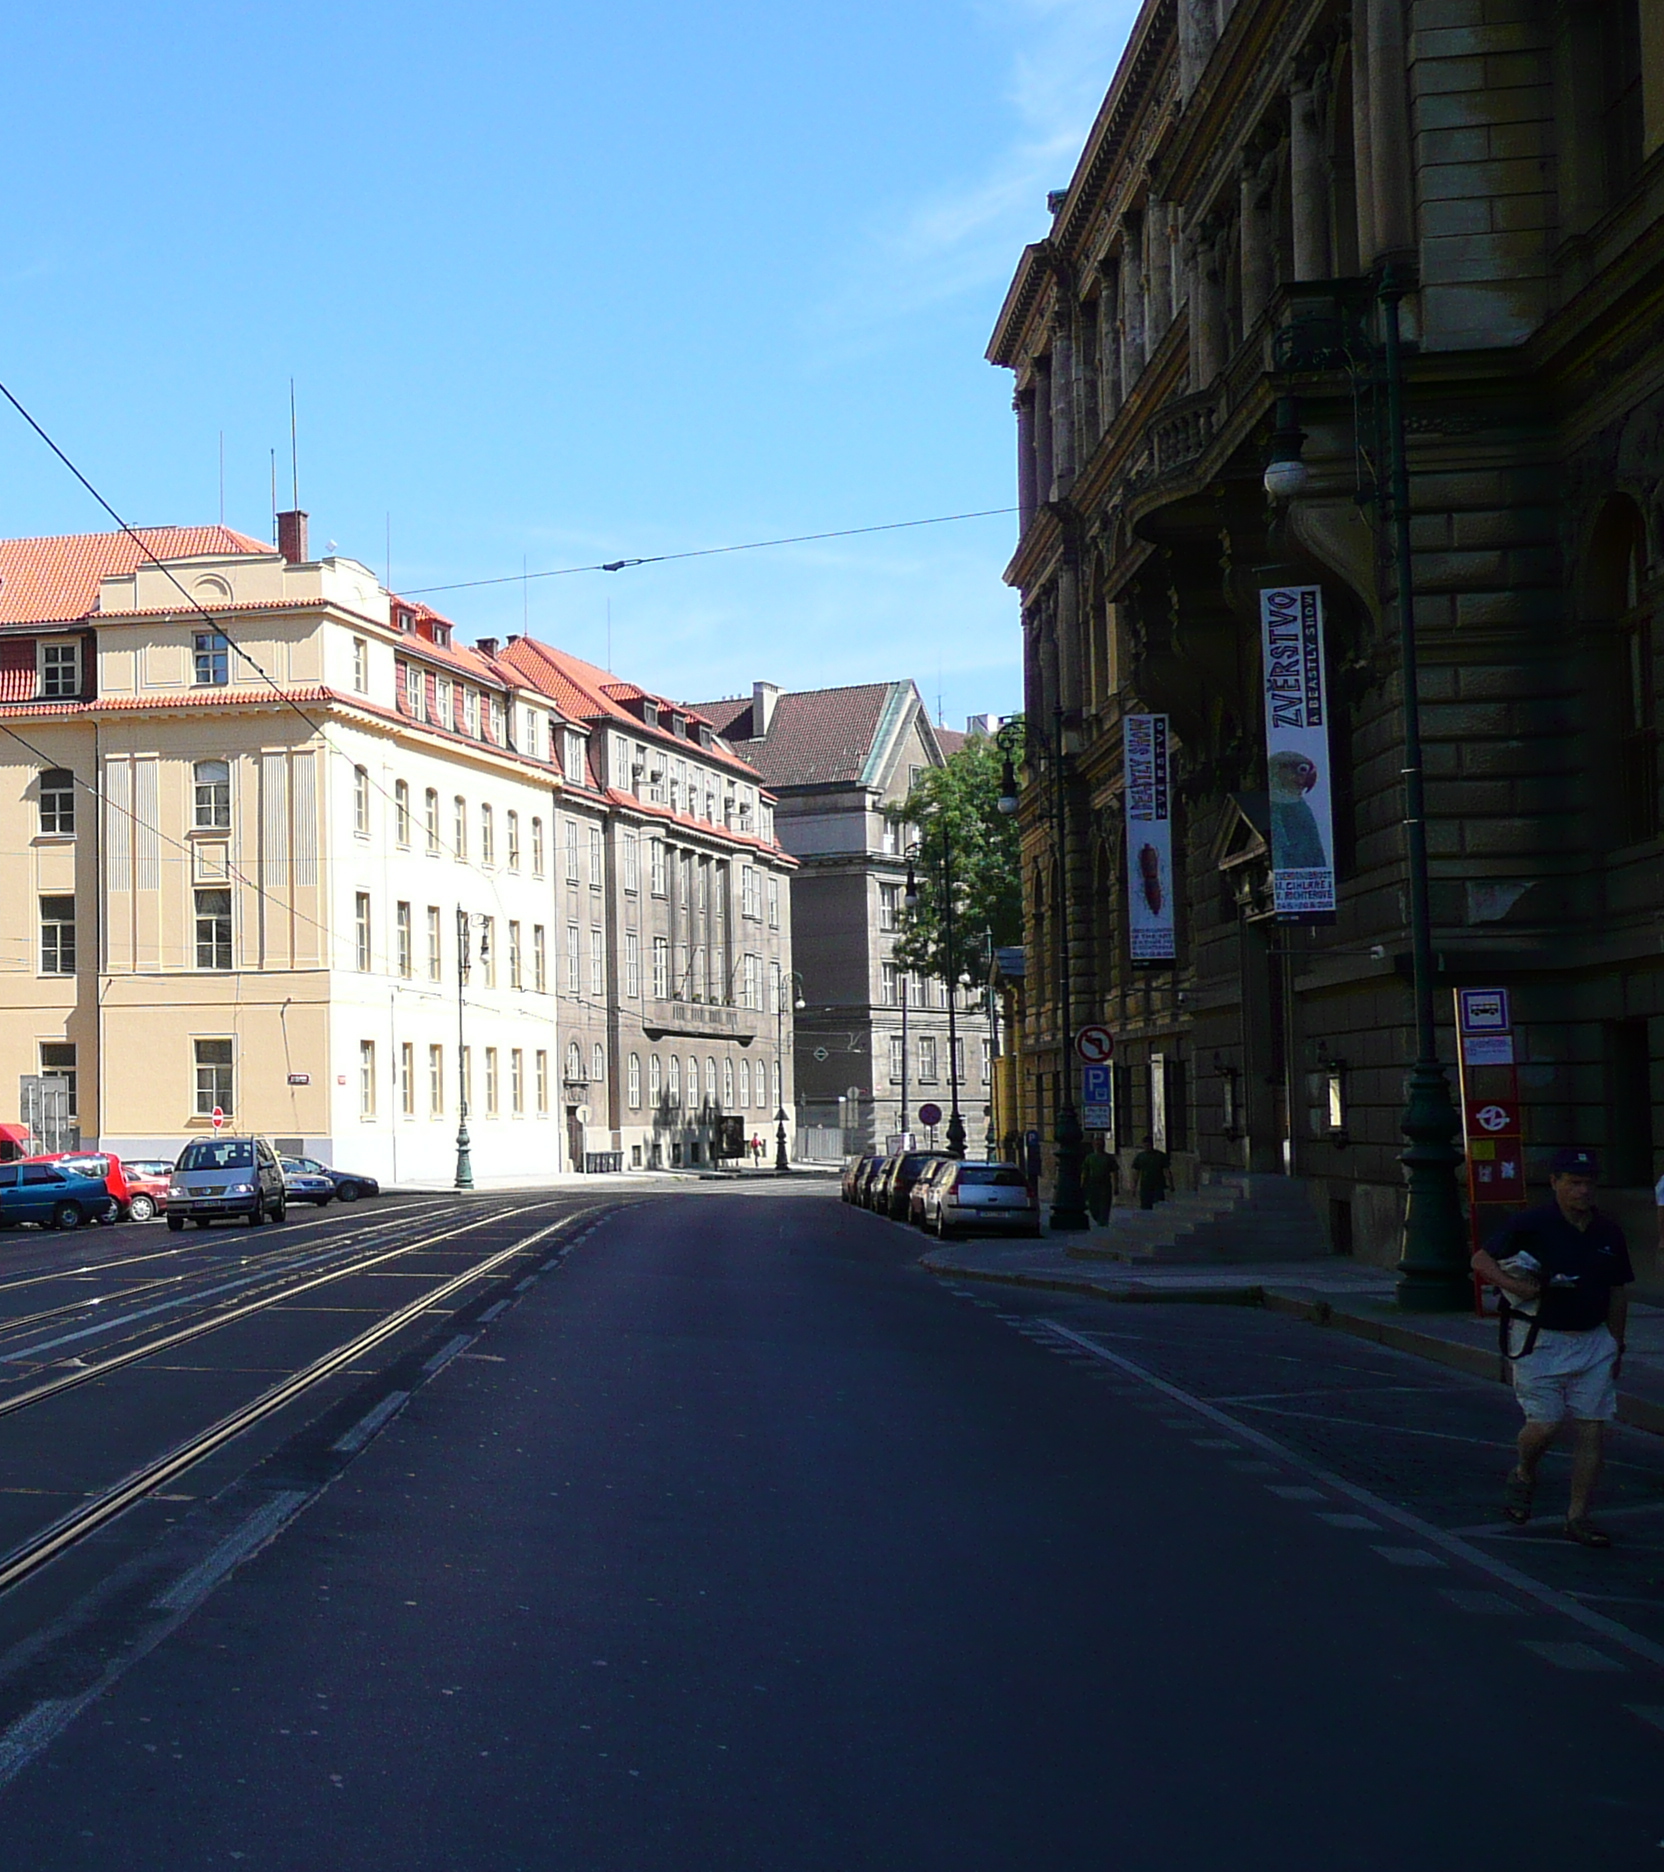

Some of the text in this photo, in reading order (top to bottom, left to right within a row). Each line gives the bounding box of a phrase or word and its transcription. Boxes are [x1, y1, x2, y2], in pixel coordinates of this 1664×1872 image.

[1303, 594, 1316, 635] SHOW
[1266, 591, 1303, 728] ZVĚRSTVO
[1306, 643, 1319, 708] BEASTLY
[1089, 1068, 1104, 1091] P
